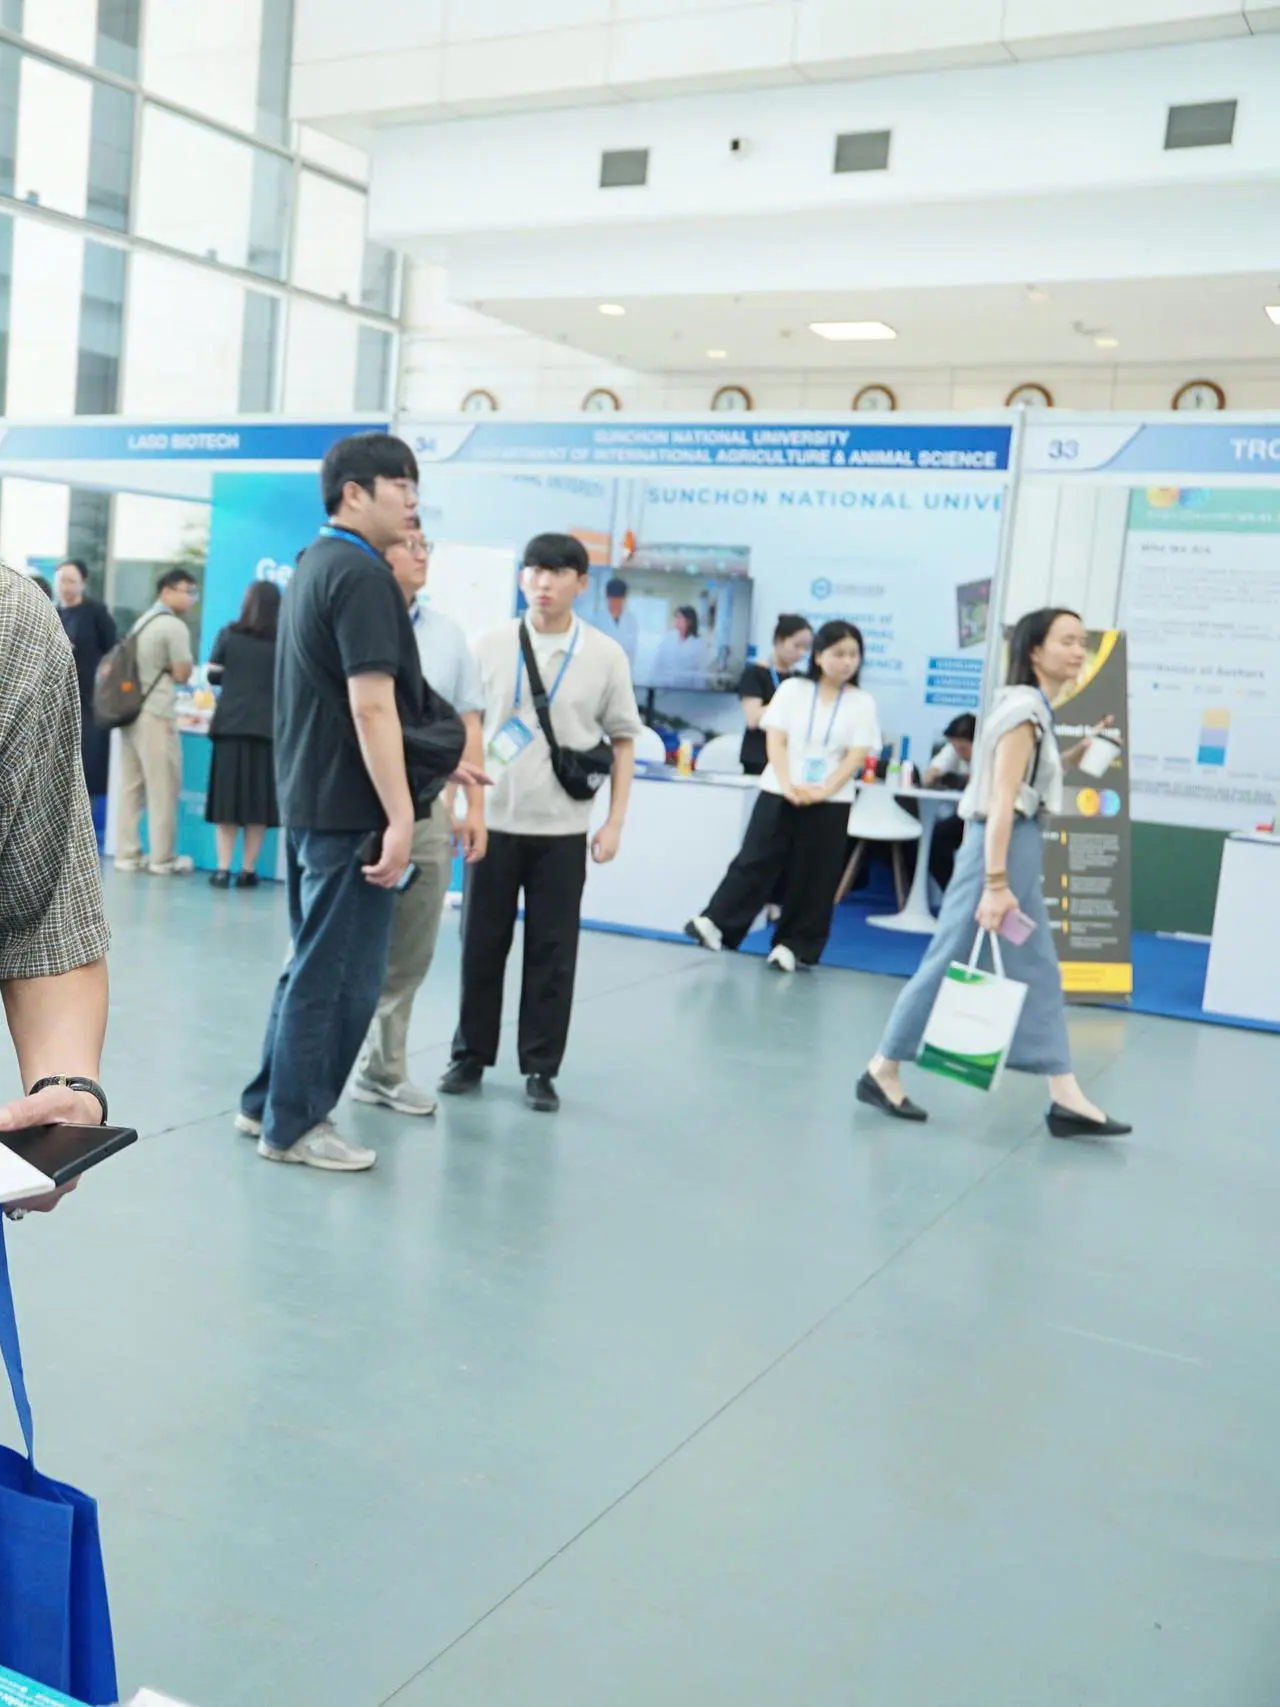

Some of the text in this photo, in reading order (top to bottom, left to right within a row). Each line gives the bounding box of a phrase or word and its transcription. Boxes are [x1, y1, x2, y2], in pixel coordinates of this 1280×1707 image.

[673, 429, 749, 445] NATIONAL
[753, 430, 850, 446] UNIVERSITY
[716, 448, 830, 465] AGRICULTURE
[849, 450, 915, 467] ANIMAL
[918, 452, 997, 468] SCIENCE
[1048, 438, 1079, 460] 33
[648, 486, 768, 505] SUNCHON
[780, 489, 912, 509] NATIONAL
